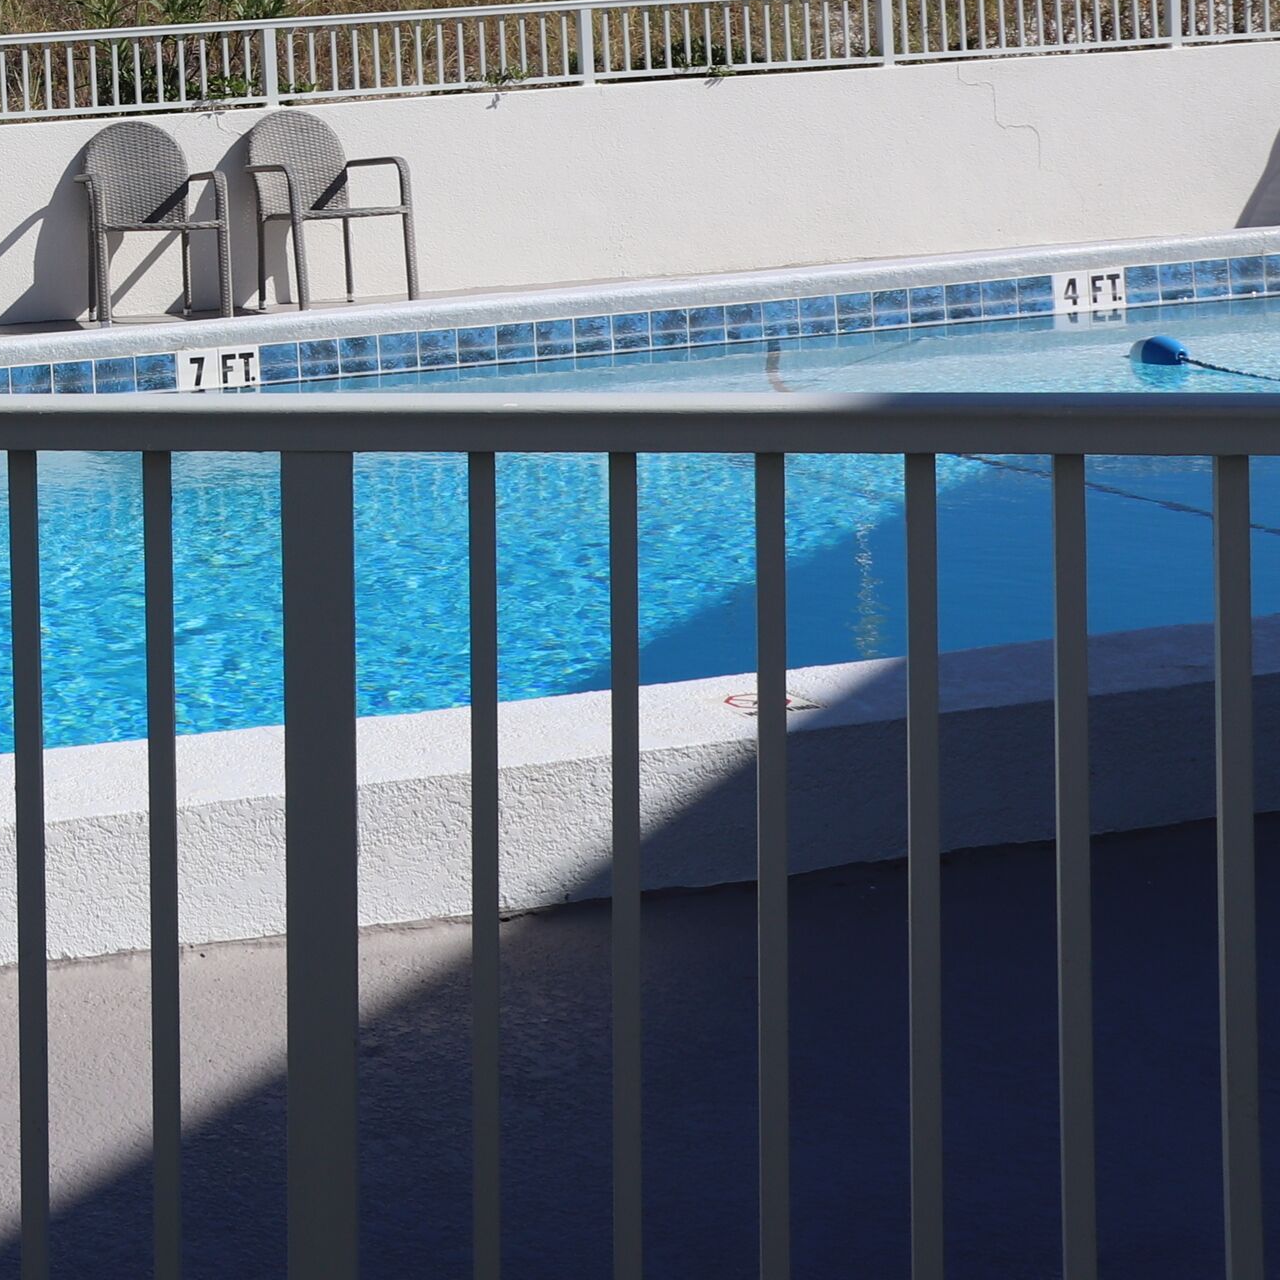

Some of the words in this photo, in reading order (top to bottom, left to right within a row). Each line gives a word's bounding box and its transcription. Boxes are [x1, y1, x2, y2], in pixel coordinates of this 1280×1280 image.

[1064, 277, 1079, 306] 4
[1091, 273, 1122, 303] FT.
[189, 357, 205, 387] 7
[221, 352, 256, 384] FT.
